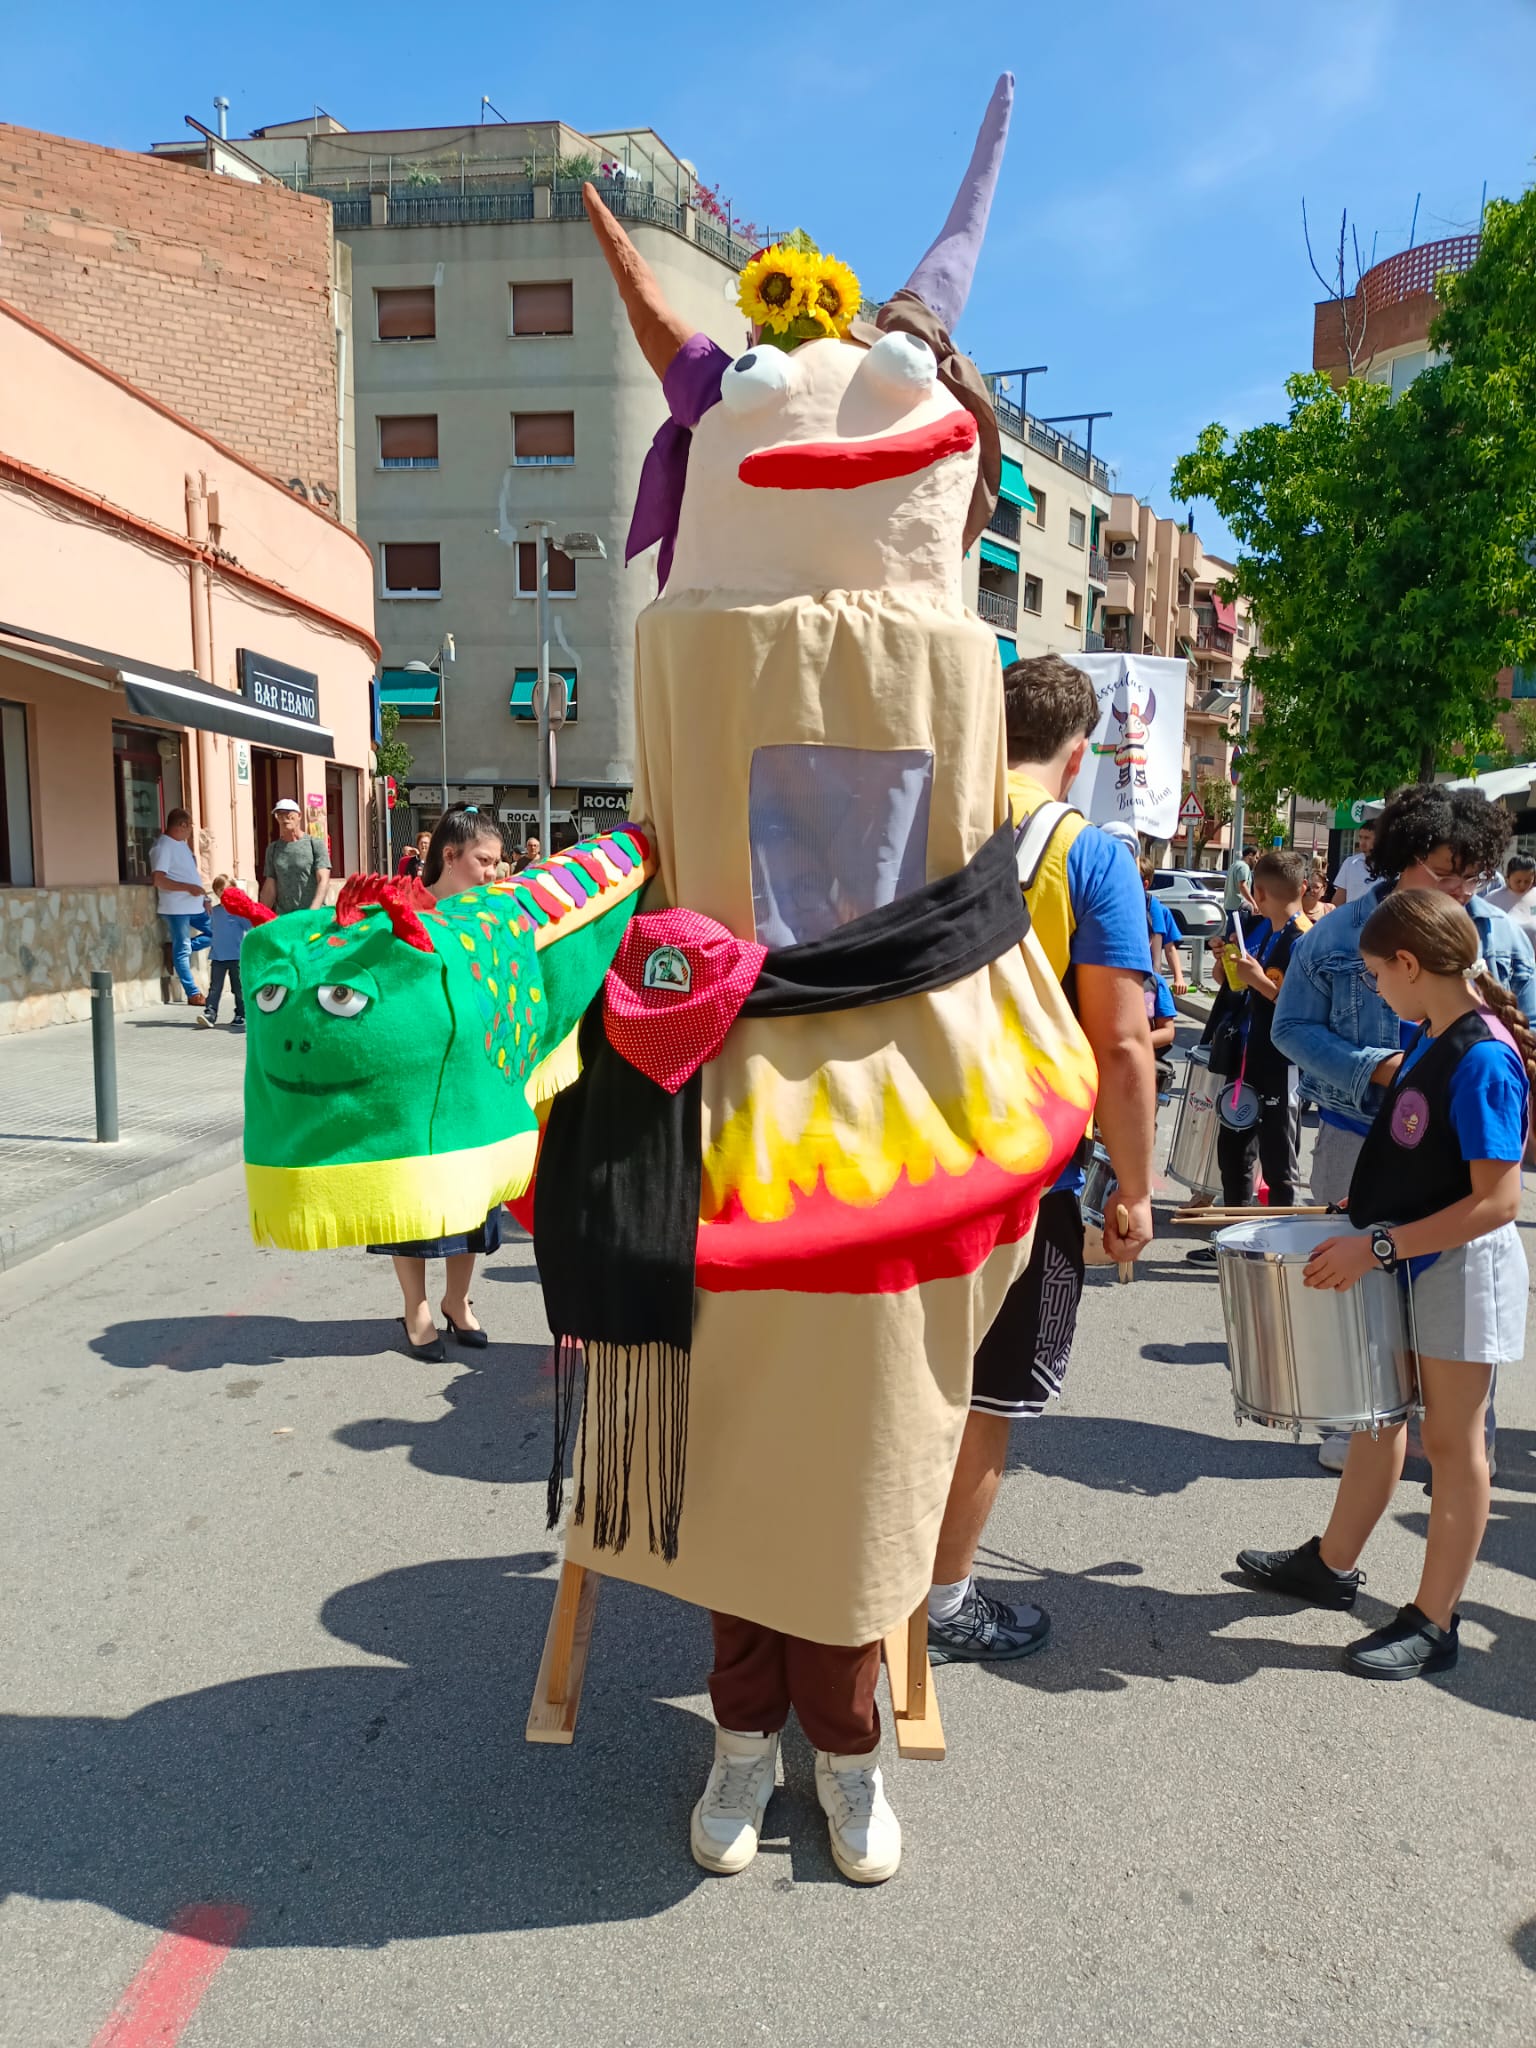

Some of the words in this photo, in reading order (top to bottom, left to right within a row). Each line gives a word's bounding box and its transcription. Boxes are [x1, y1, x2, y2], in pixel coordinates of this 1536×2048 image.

[254, 681, 278, 710] BAR
[281, 689, 315, 719] EBANO
[584, 796, 625, 808] ROCA
[507, 813, 537, 822] ROCA
